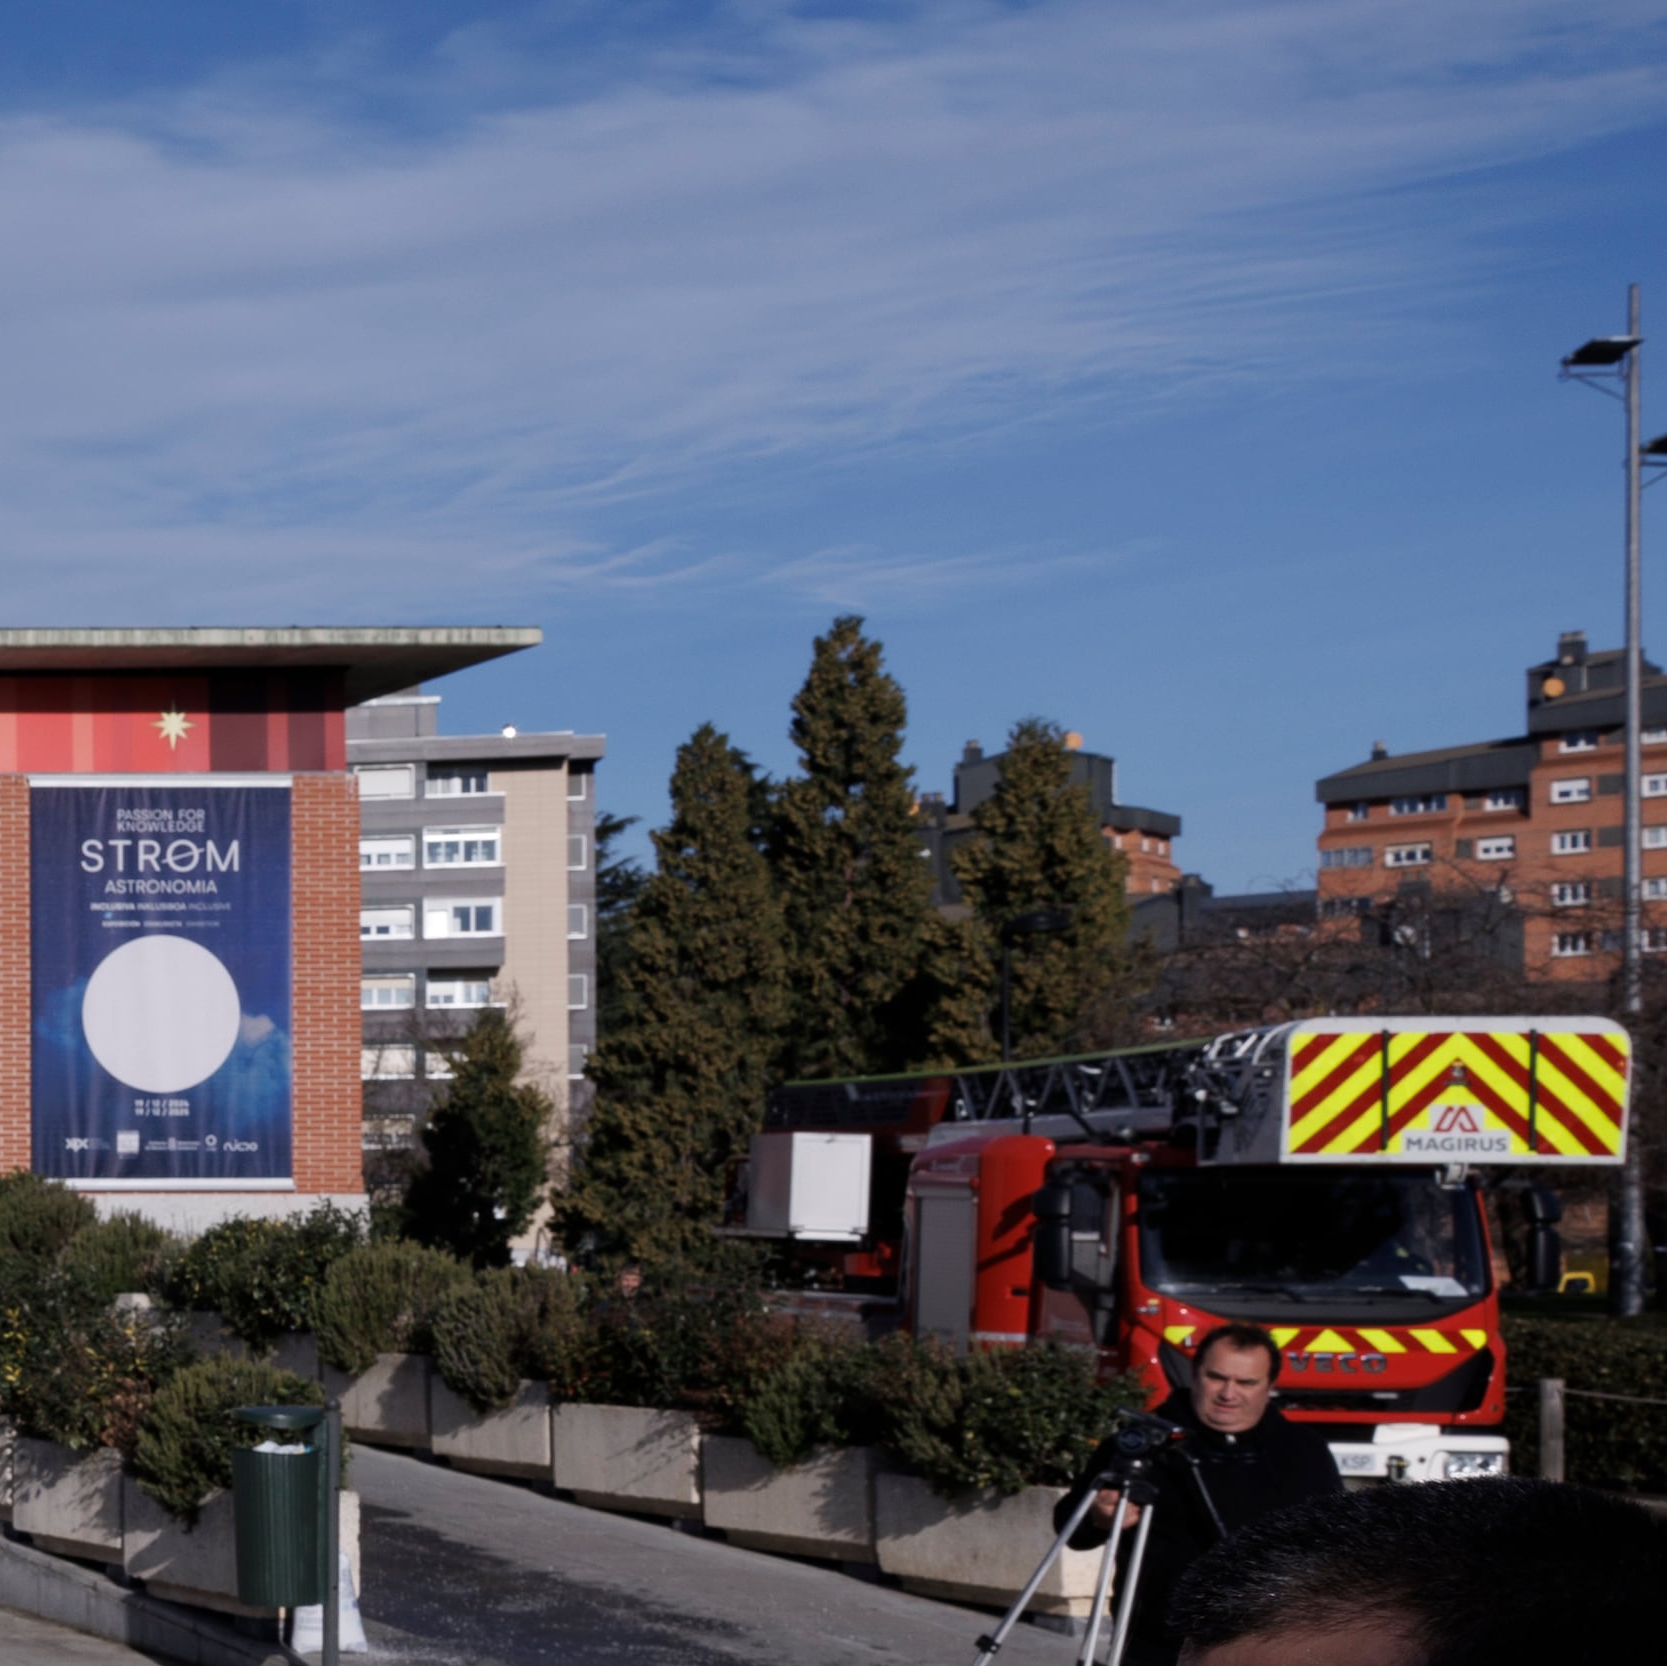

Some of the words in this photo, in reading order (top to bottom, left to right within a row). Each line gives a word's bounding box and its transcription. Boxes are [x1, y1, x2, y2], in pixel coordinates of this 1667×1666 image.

[117, 809, 173, 821] PASSION
[178, 809, 205, 821] FOR
[117, 820, 205, 833] KNOWLEDGE
[104, 879, 218, 895] ASTRONOMIA
[1406, 1137, 1507, 1152] MAGIRUS
[1286, 1352, 1388, 1374] VECO
